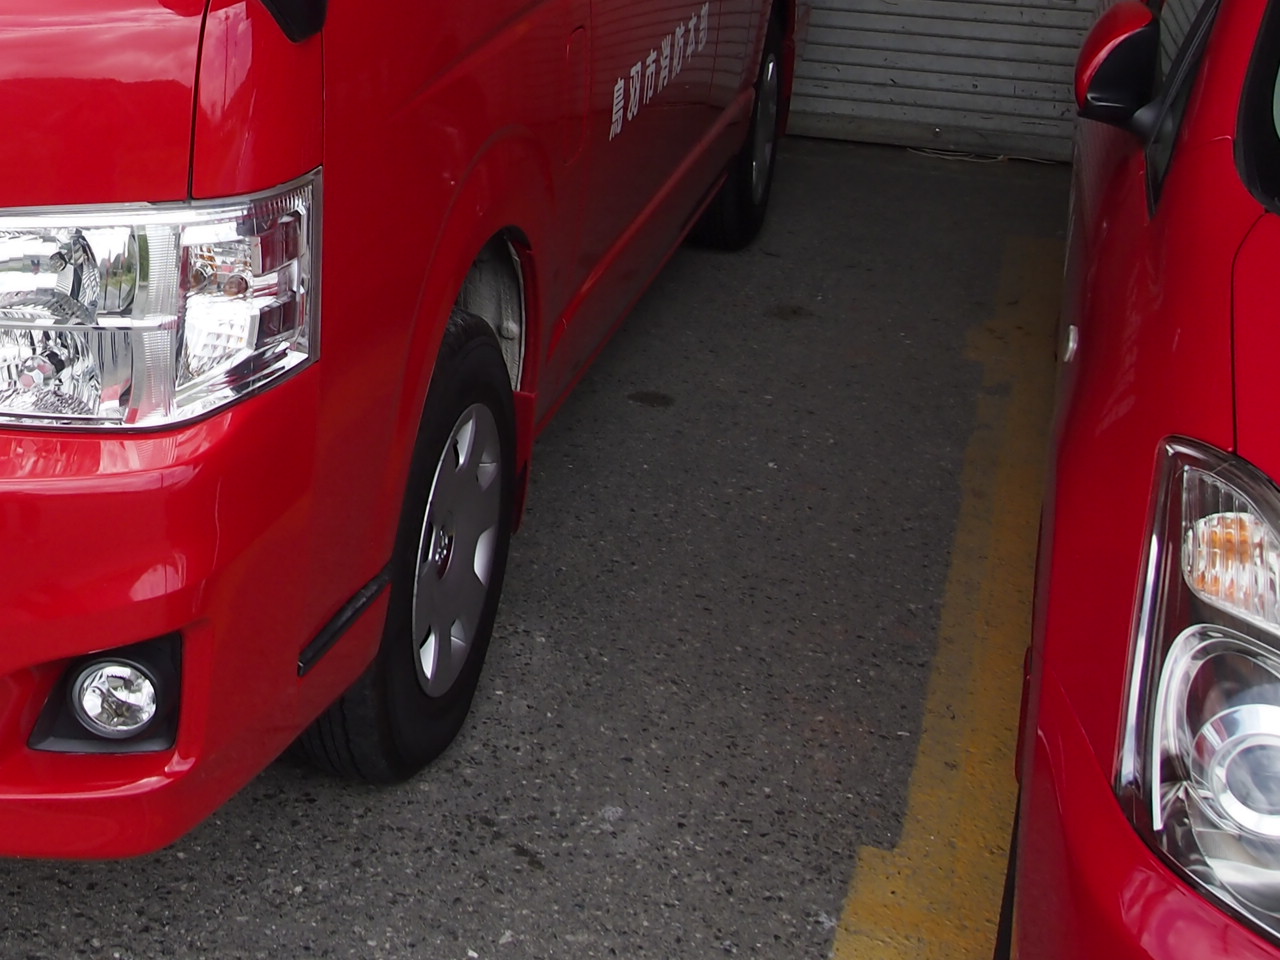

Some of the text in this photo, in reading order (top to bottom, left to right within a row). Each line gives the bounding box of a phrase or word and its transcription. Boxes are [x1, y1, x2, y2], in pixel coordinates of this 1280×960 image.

[608, 1, 709, 142] 鳥羽市消防本部
